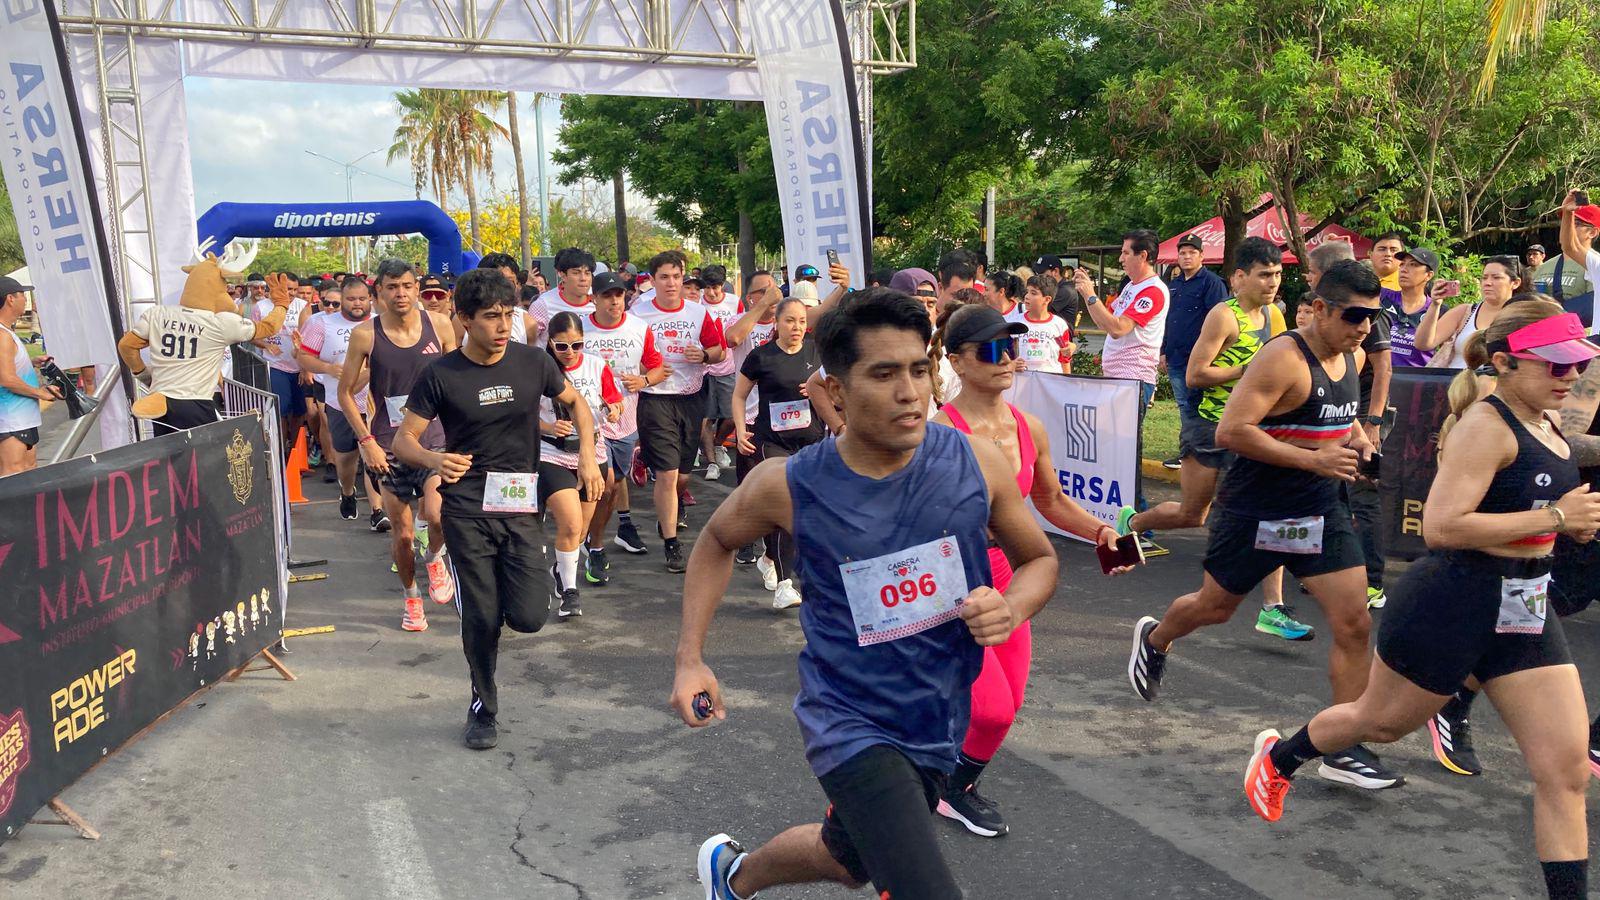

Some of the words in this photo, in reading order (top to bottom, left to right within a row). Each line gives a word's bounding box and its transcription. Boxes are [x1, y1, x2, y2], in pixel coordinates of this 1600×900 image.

[274, 211, 376, 229] dportenis
[162, 319, 205, 336] VENNY
[650, 320, 697, 332] CARRERA
[160, 333, 199, 359] 911
[585, 338, 635, 350] CARRERA
[666, 345, 685, 354] 025
[780, 410, 801, 421] 079
[500, 486, 527, 499] 165
[1054, 469, 1123, 508] ERSA
[35, 447, 200, 569] IMDEM
[1276, 526, 1308, 540] 189
[887, 556, 921, 572] CARRERA
[879, 573, 937, 608] 096
[50, 648, 137, 722] POWER
